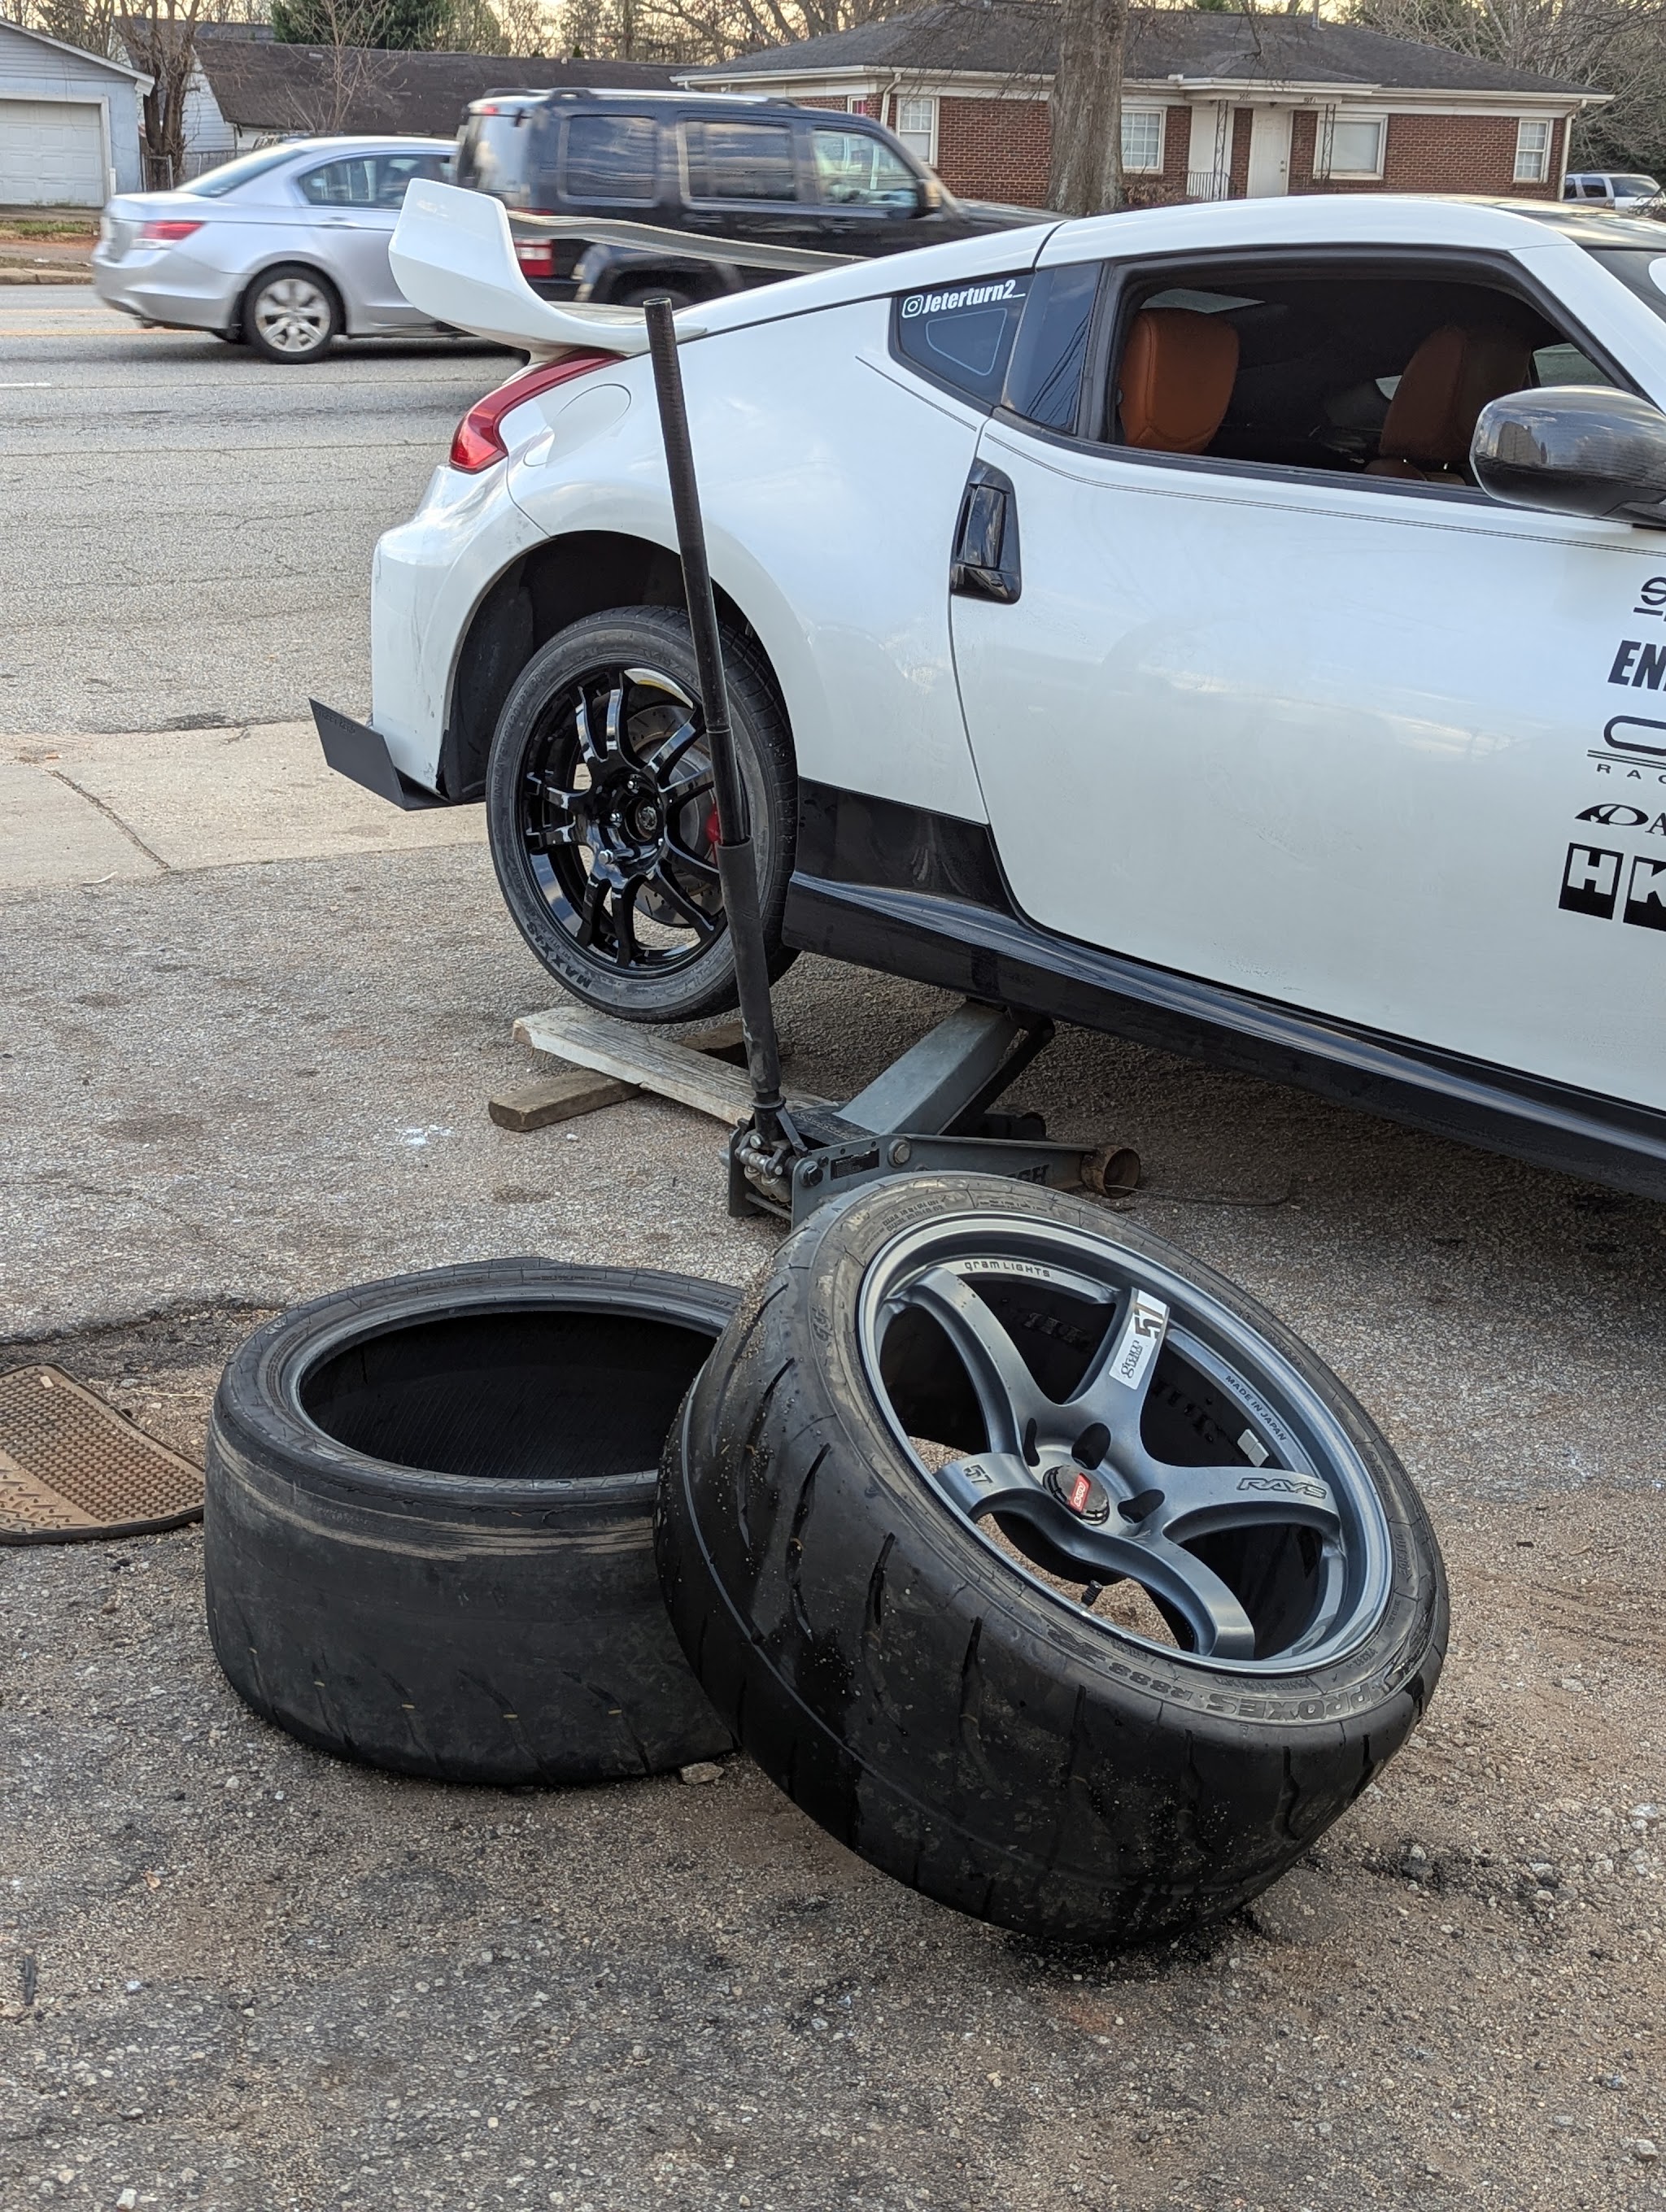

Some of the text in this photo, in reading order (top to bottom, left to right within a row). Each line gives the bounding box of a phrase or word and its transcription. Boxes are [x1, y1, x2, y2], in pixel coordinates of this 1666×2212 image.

[1003, 1261, 1050, 1278] LIGHTS
[1225, 1375, 1288, 1441] MADE IN JAPAN
[1236, 1477, 1328, 1500] RAYS
[1206, 1682, 1373, 1720] PROXES
